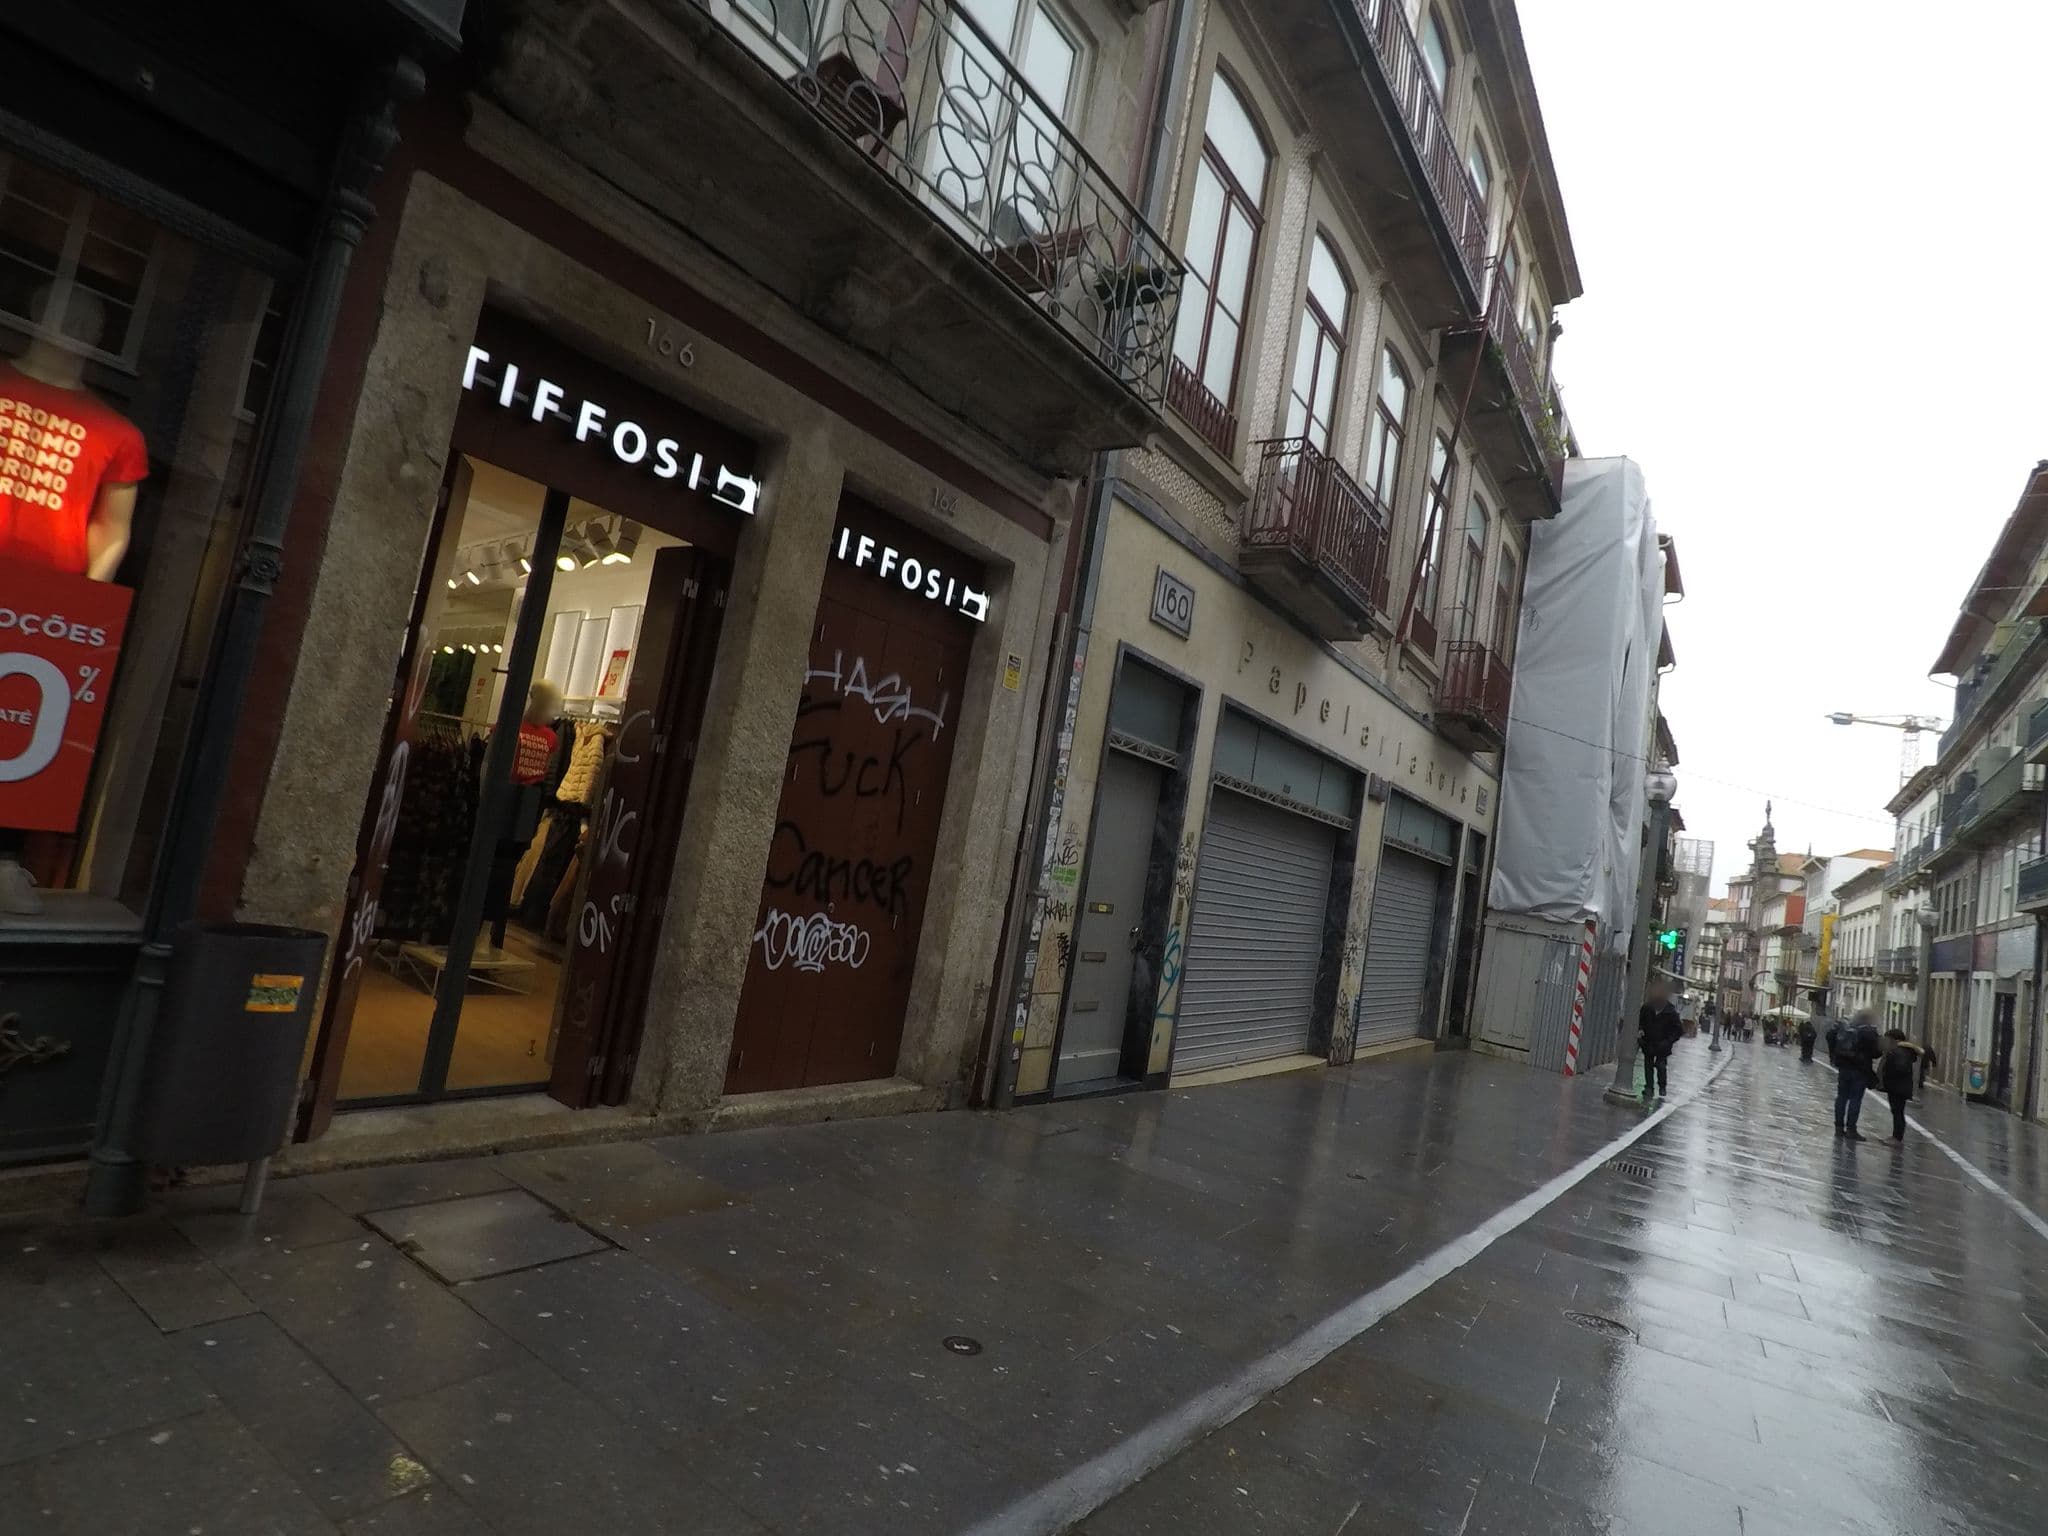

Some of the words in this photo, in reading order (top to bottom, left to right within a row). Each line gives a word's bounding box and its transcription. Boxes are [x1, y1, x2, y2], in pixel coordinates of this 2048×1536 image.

[645, 317, 697, 368] 166
[0, 398, 87, 441] PROMO
[1162, 583, 1189, 622] 160
